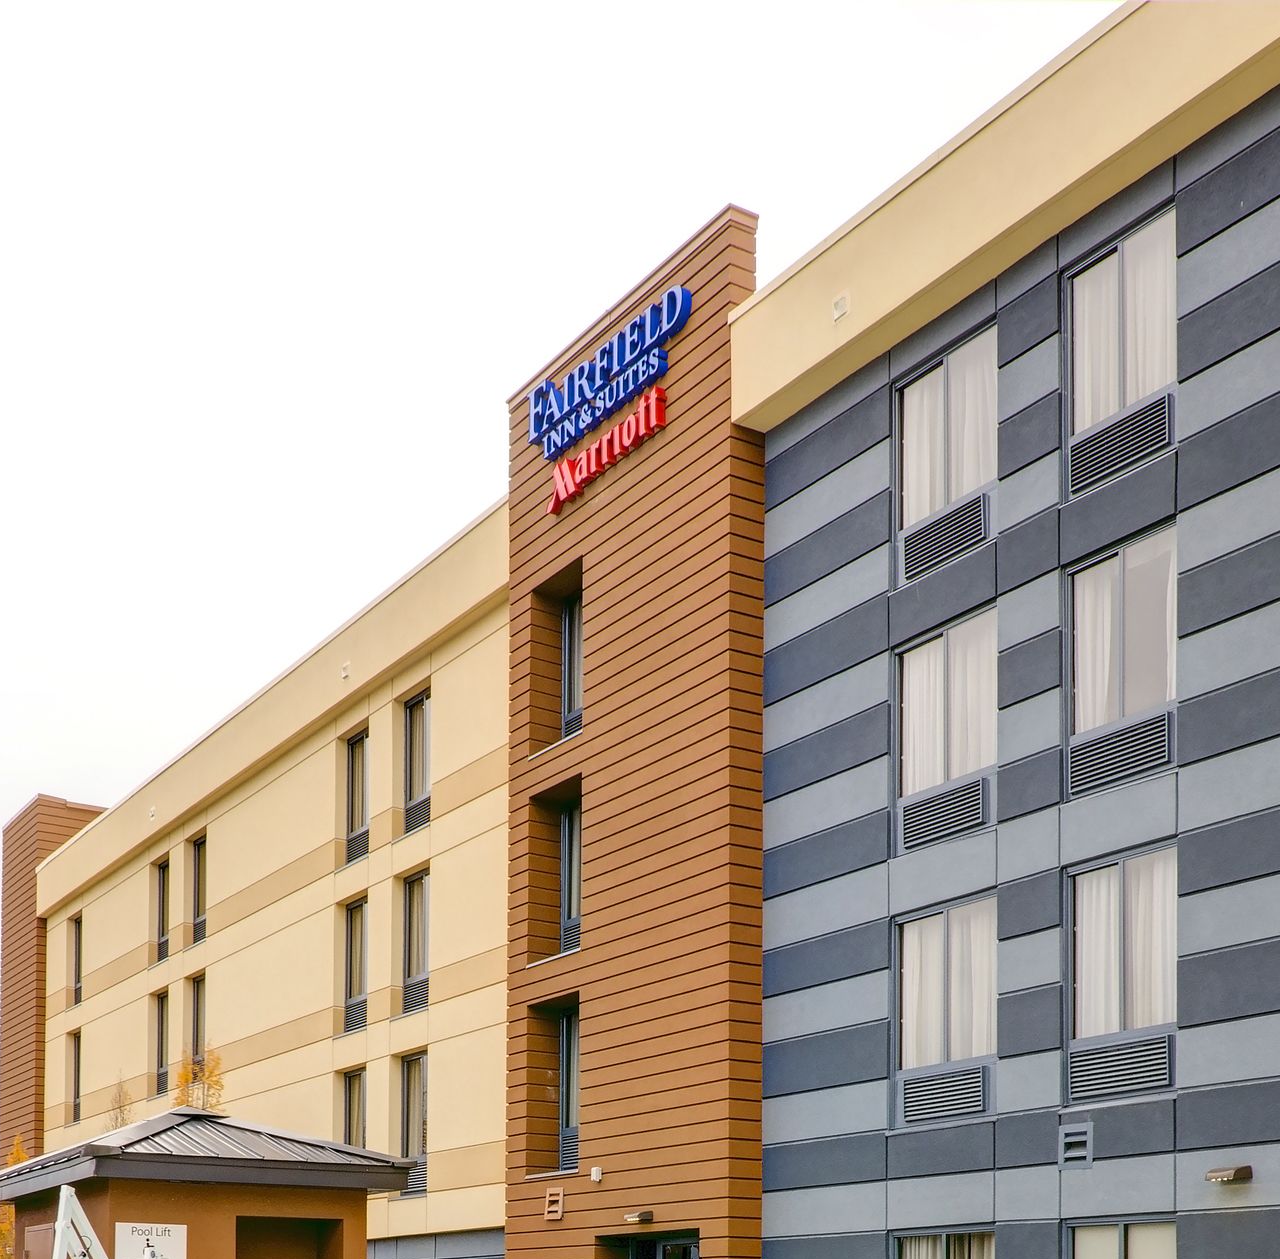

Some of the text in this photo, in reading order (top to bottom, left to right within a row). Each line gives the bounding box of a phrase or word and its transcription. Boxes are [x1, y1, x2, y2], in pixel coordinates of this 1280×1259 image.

[527, 284, 692, 445] FAIRFIELD
[543, 346, 668, 461] INN & SUITES
[546, 385, 667, 515] Marriott
[131, 1226, 171, 1237] Pool Lift
